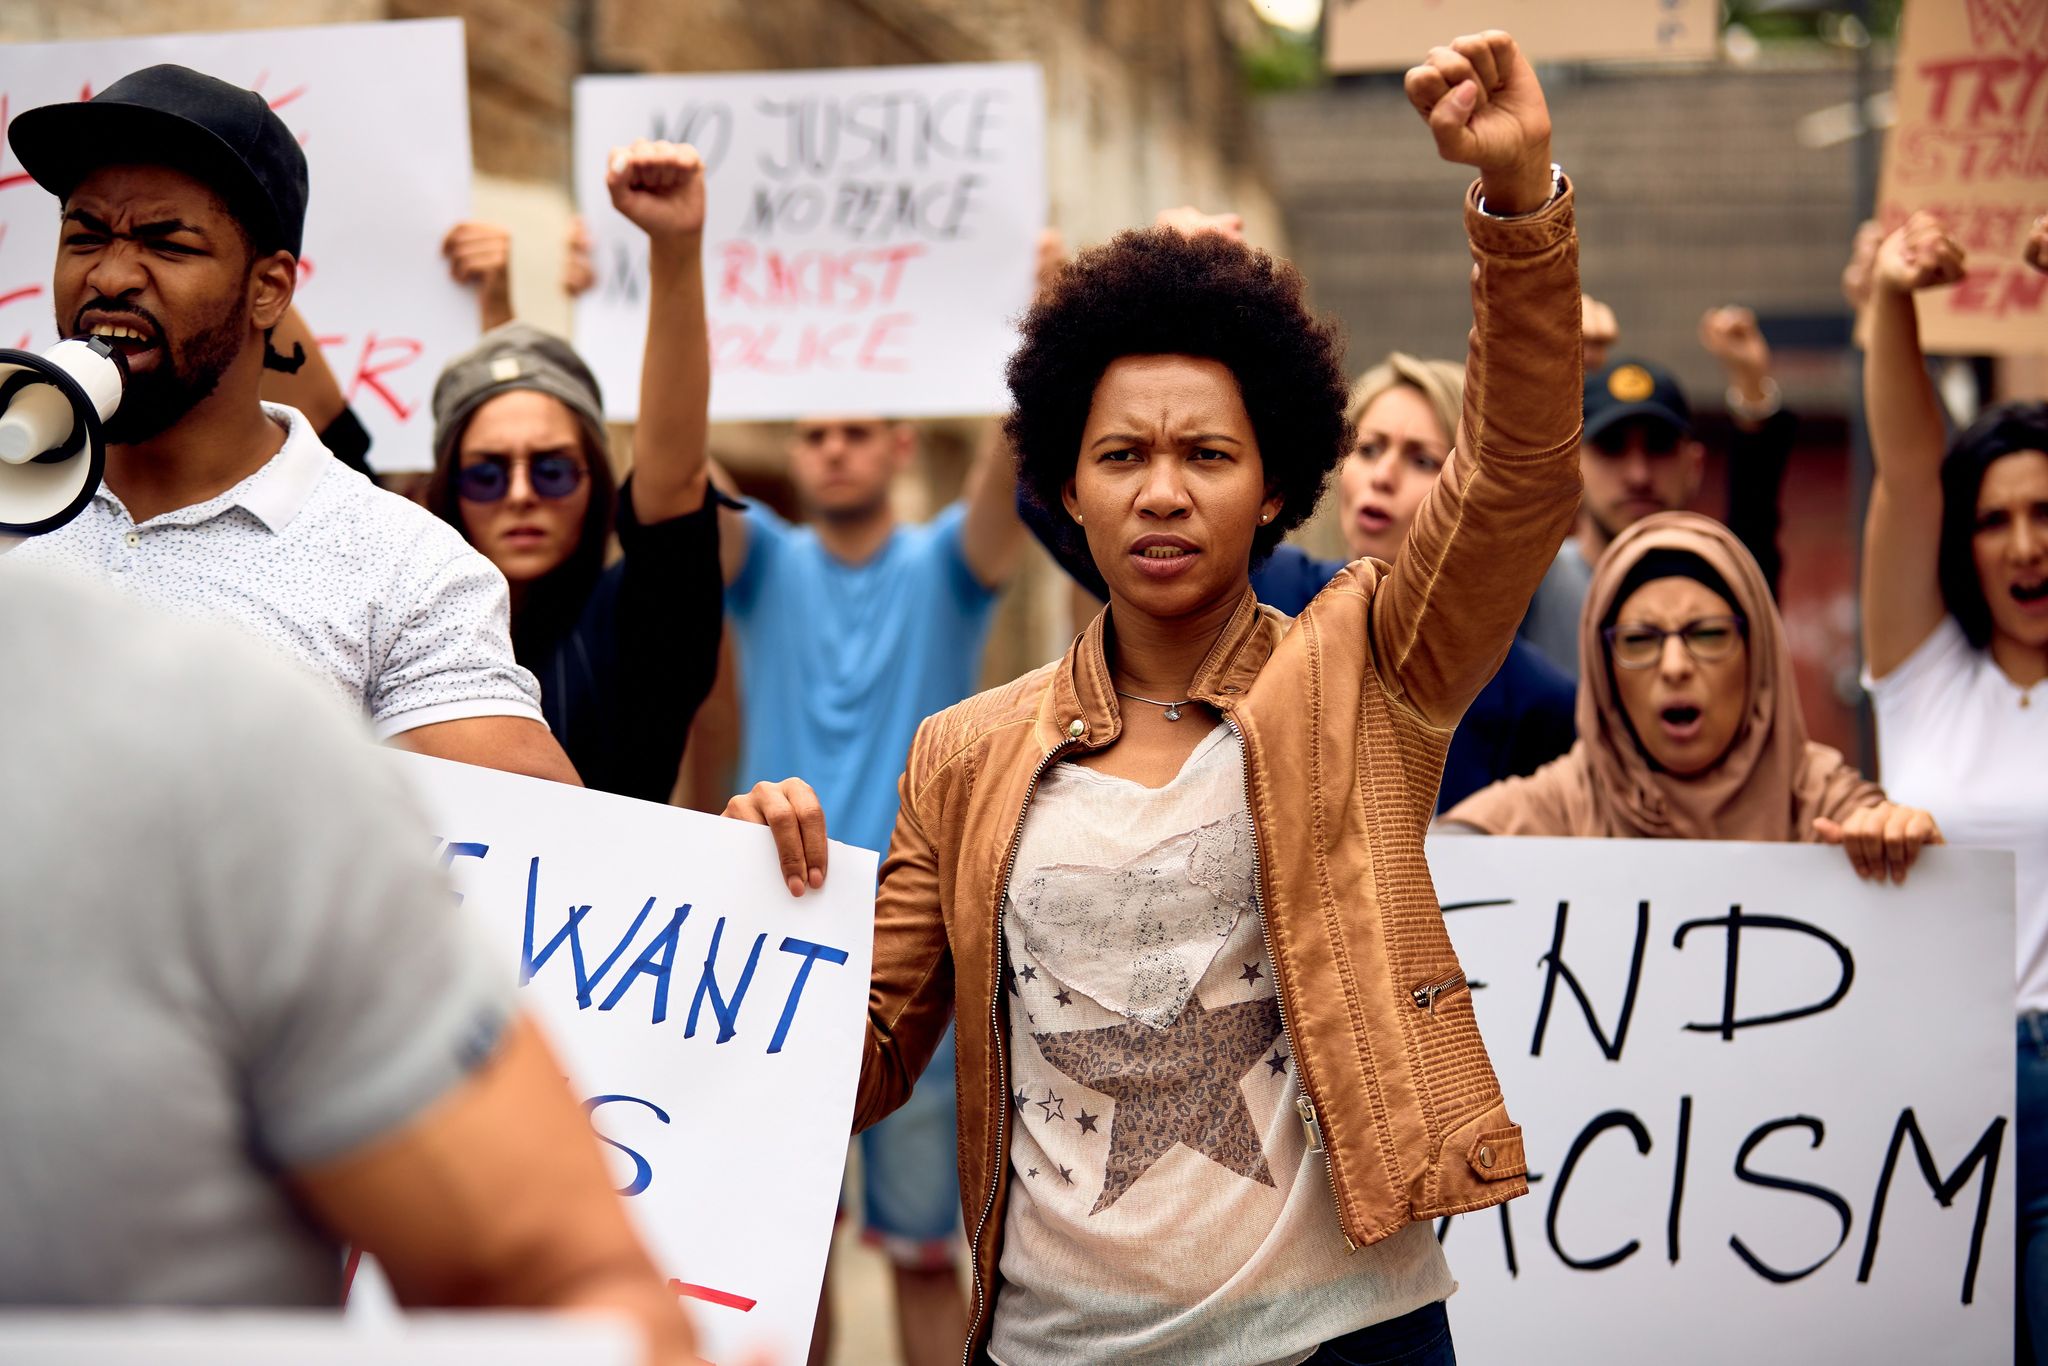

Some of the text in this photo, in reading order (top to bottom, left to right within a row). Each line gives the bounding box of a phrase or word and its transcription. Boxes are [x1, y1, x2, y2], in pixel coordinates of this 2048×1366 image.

[755, 88, 1008, 178] JUSTICE
[738, 182, 828, 239] NO
[717, 240, 928, 312] RACIST
[708, 312, 914, 374] OLICE
[518, 856, 849, 1054] WANT
